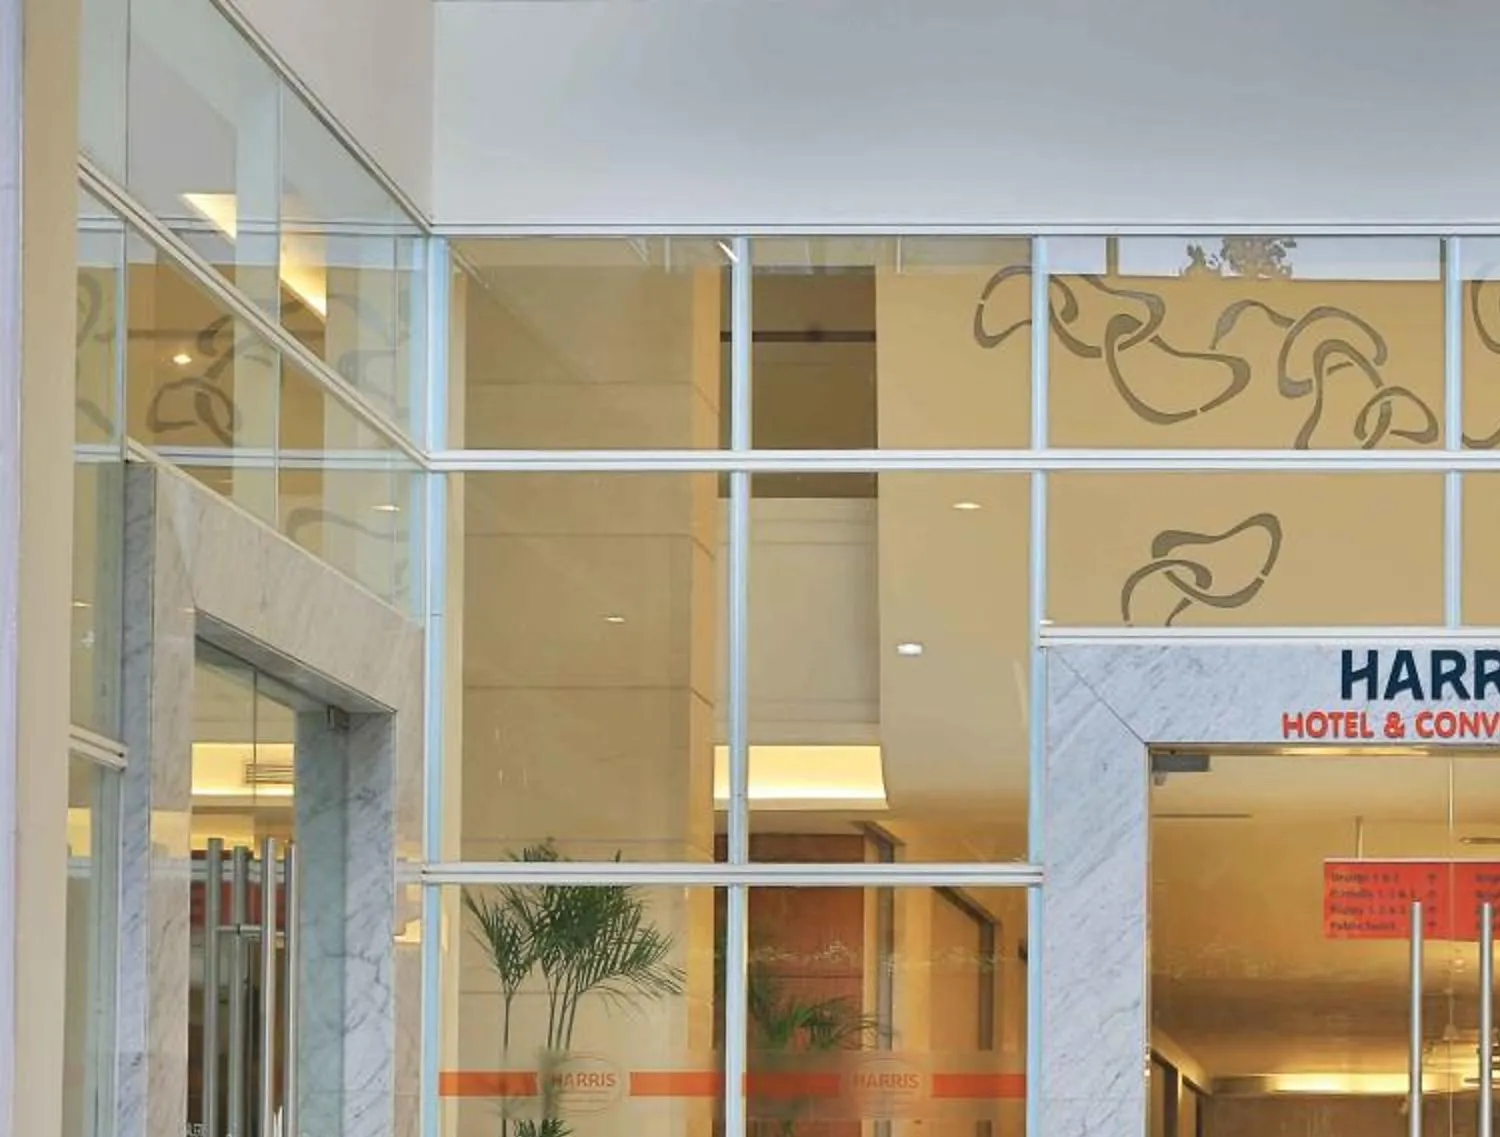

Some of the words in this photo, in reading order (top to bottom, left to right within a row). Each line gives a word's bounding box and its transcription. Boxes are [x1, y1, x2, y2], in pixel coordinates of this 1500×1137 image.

[1281, 711, 1375, 739] HOTEL
[1383, 711, 1406, 739] &
[551, 1071, 616, 1087] HARRIS
[853, 1073, 921, 1089] HARRIS
